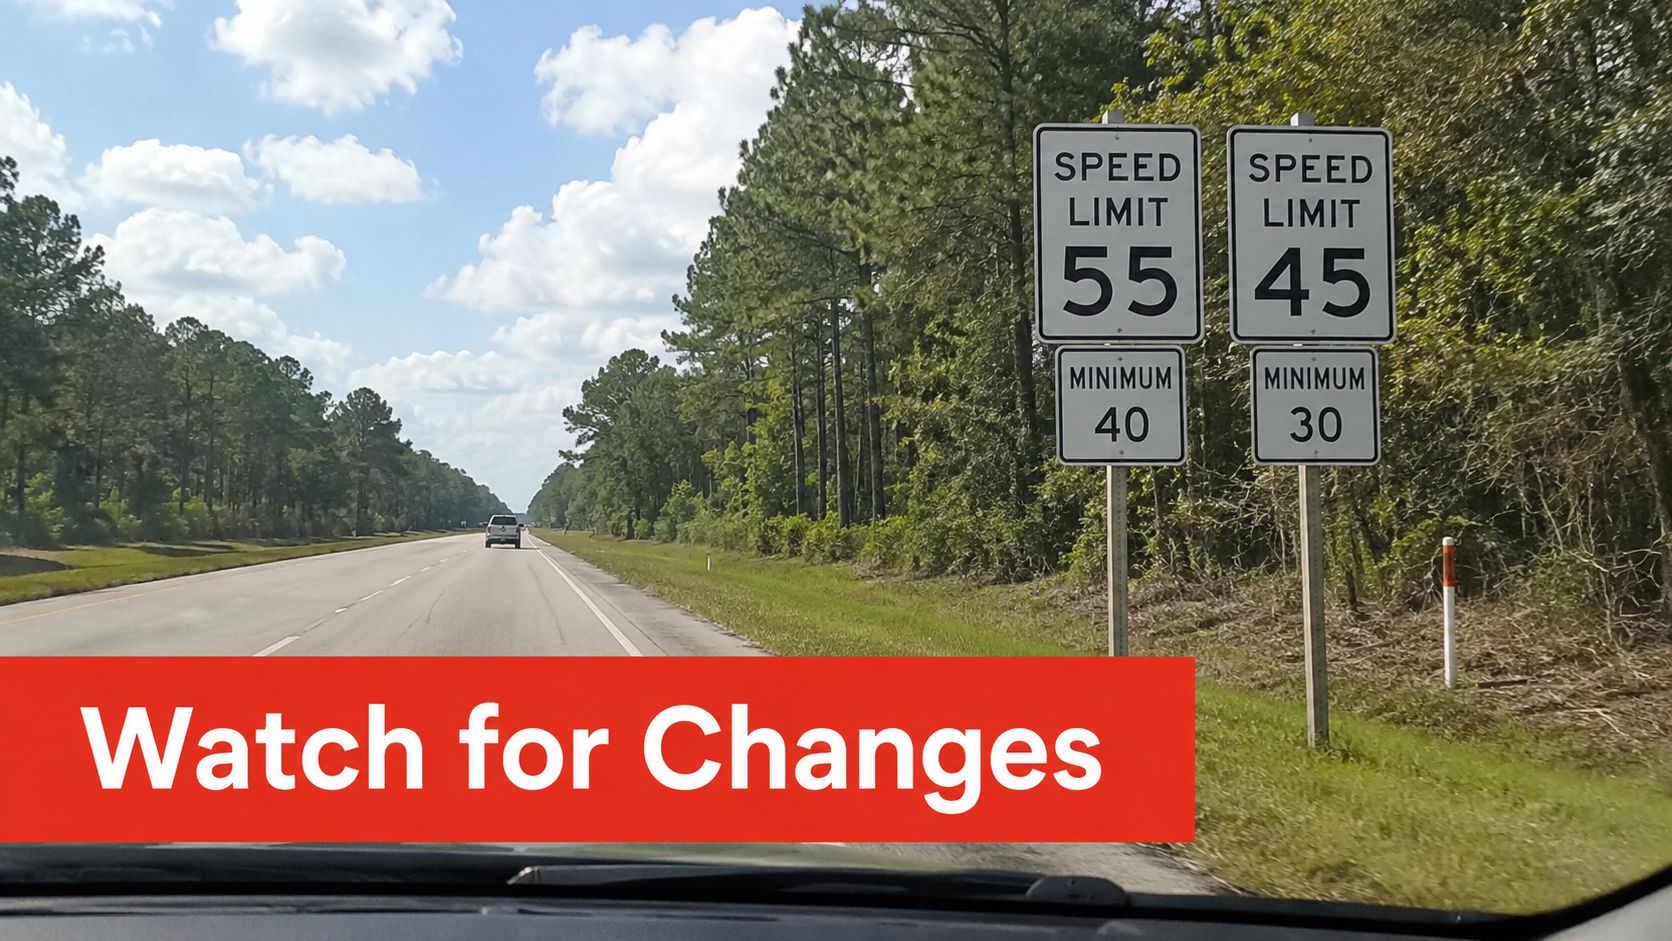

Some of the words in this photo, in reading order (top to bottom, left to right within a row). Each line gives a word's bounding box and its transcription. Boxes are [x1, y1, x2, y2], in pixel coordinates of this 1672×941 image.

[1055, 152, 1181, 181] SPEED
[1249, 153, 1372, 183] SPEED
[1070, 197, 1168, 226] LIMIT
[1264, 198, 1360, 228] LIMIT
[1063, 246, 1177, 316] 55
[1255, 247, 1370, 318] 45
[1070, 366, 1171, 389] MINIMUM
[1265, 367, 1365, 390] MINIMUM
[1095, 406, 1149, 442] 40
[1290, 407, 1342, 442] 30
